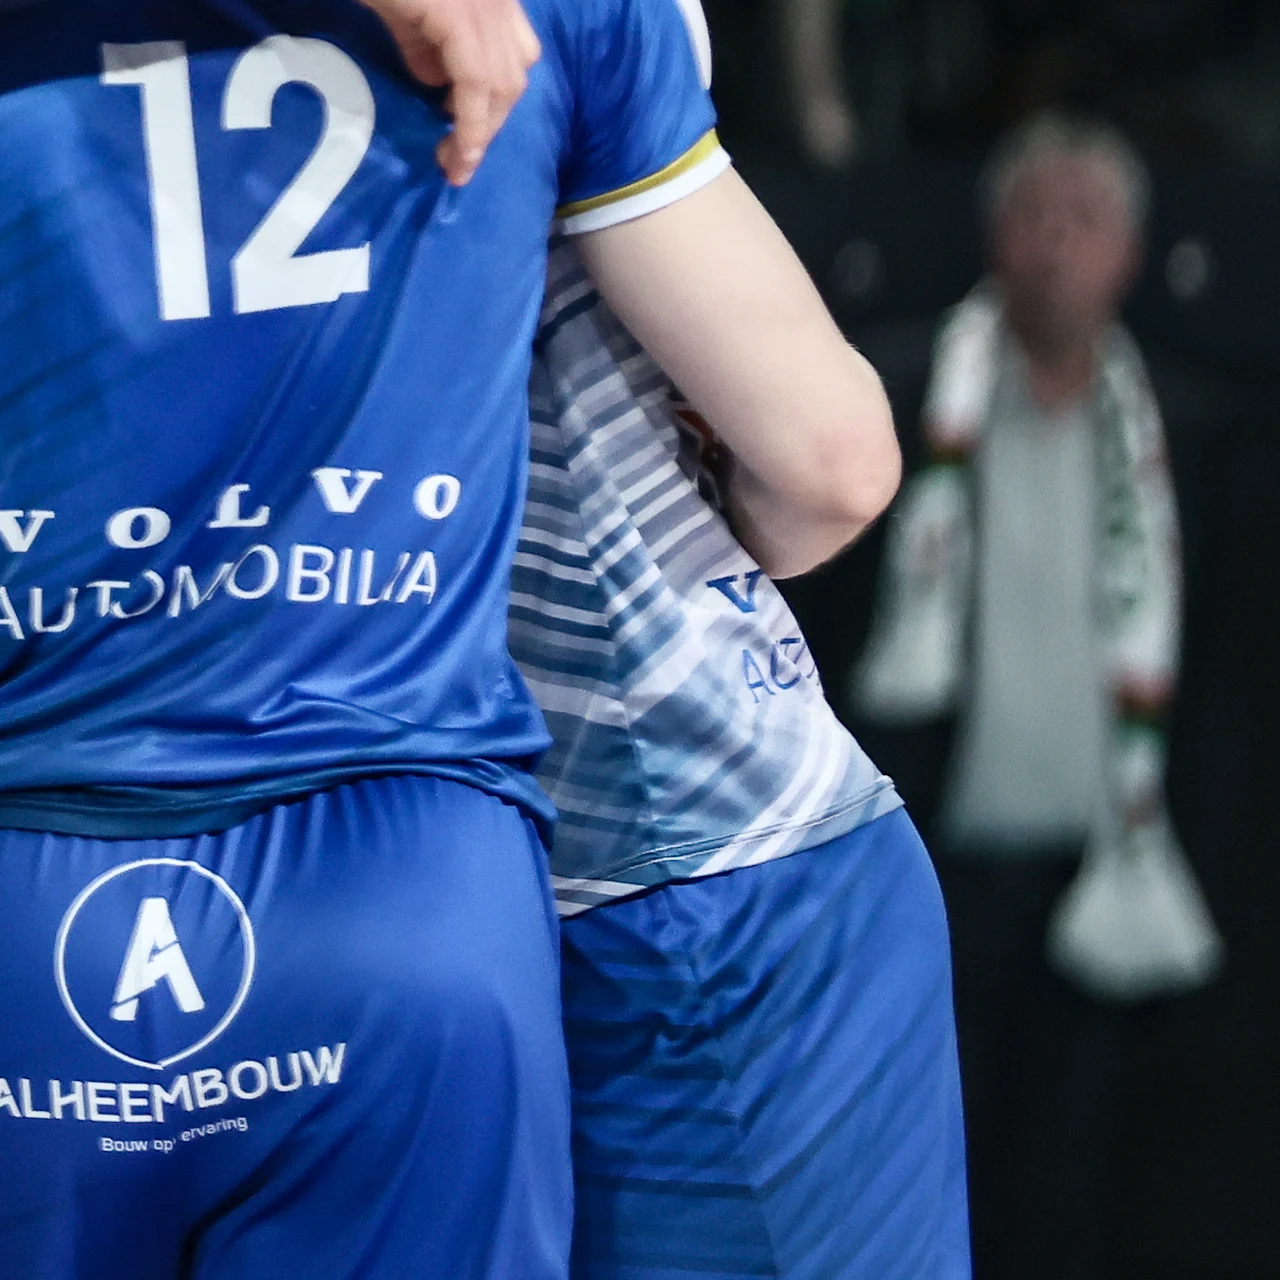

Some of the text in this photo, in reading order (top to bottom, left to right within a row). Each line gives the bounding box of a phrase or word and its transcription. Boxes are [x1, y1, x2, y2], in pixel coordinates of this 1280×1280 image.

[100, 34, 376, 320] 12
[100, 1137, 148, 1152] Bouw
[181, 1117, 248, 1142] ervaring
